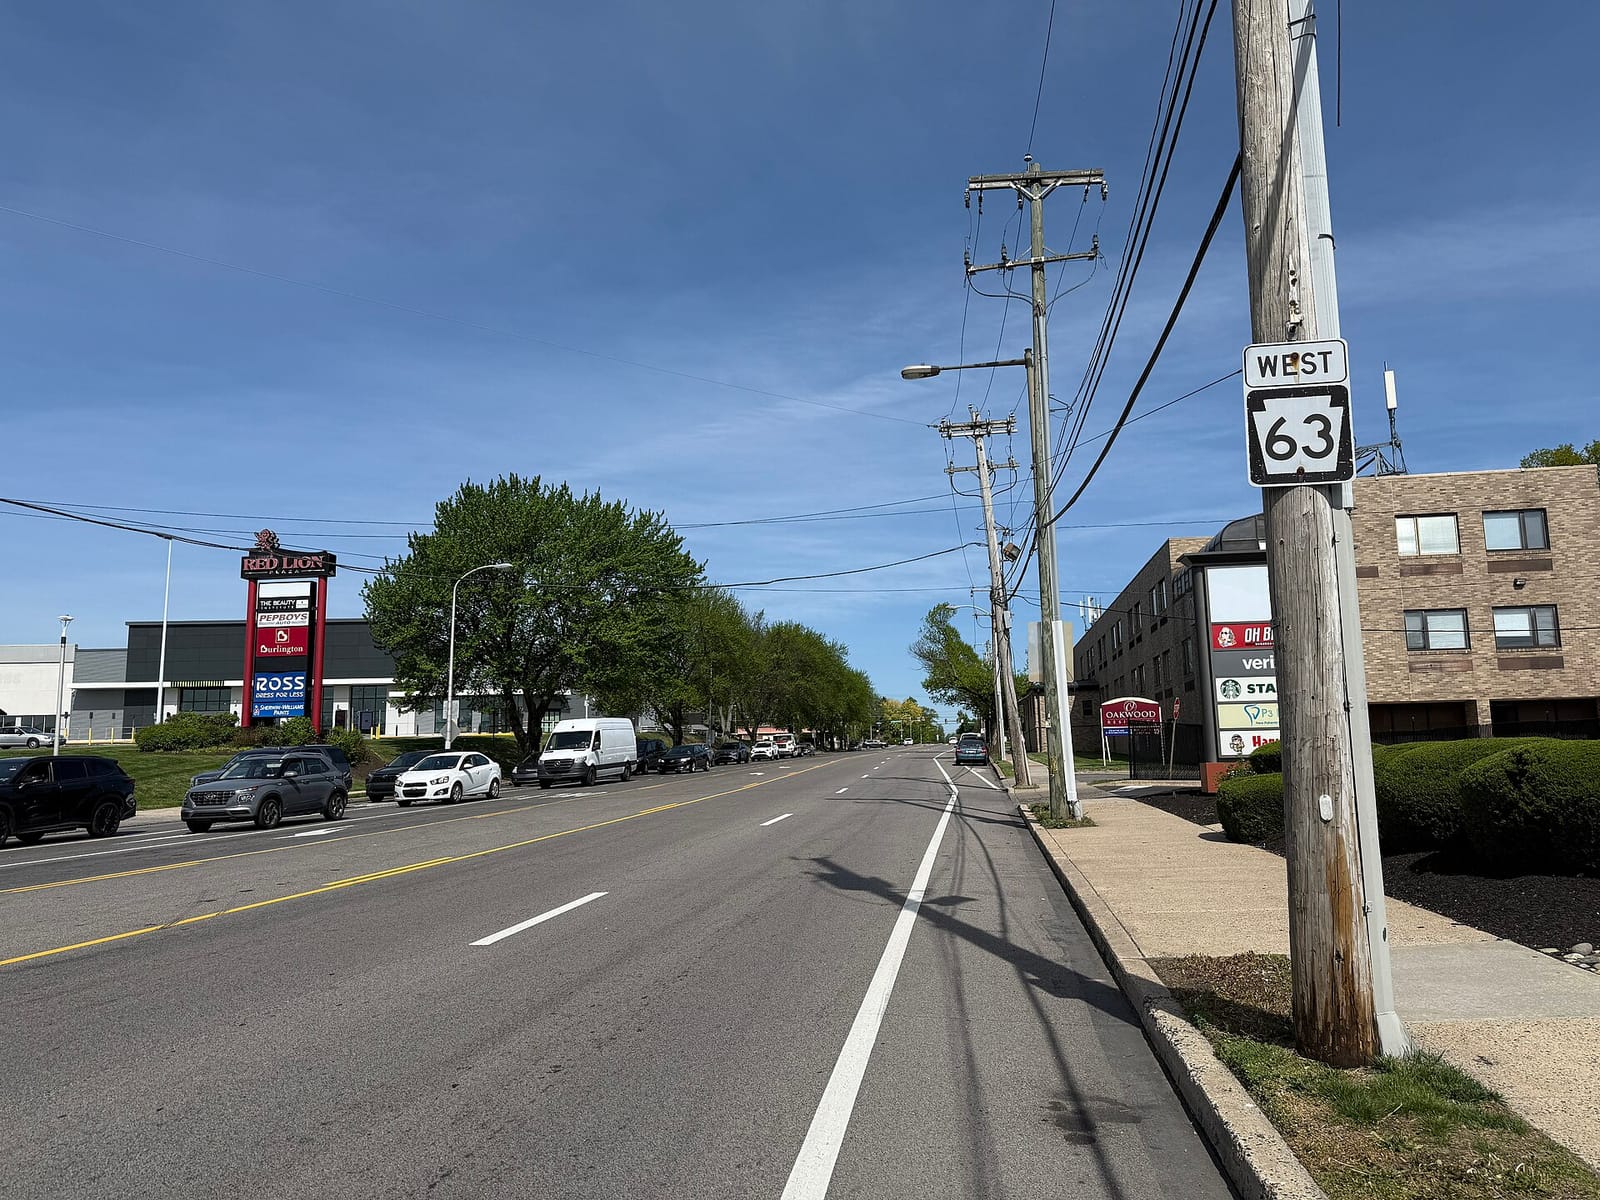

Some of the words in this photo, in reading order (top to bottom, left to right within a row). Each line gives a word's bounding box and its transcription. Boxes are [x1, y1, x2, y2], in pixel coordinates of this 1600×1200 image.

[1257, 351, 1333, 378] WEST
[1265, 413, 1334, 461] 63
[243, 558, 278, 570] RED
[283, 556, 324, 569] LION
[1244, 627, 1260, 643] OH
[260, 645, 304, 655] Burlington
[1242, 655, 1275, 670] veri
[256, 676, 305, 691] ROSS
[1247, 683, 1276, 694] STA
[1106, 711, 1156, 719] OAKWOOD
[1261, 708, 1274, 718] P3
